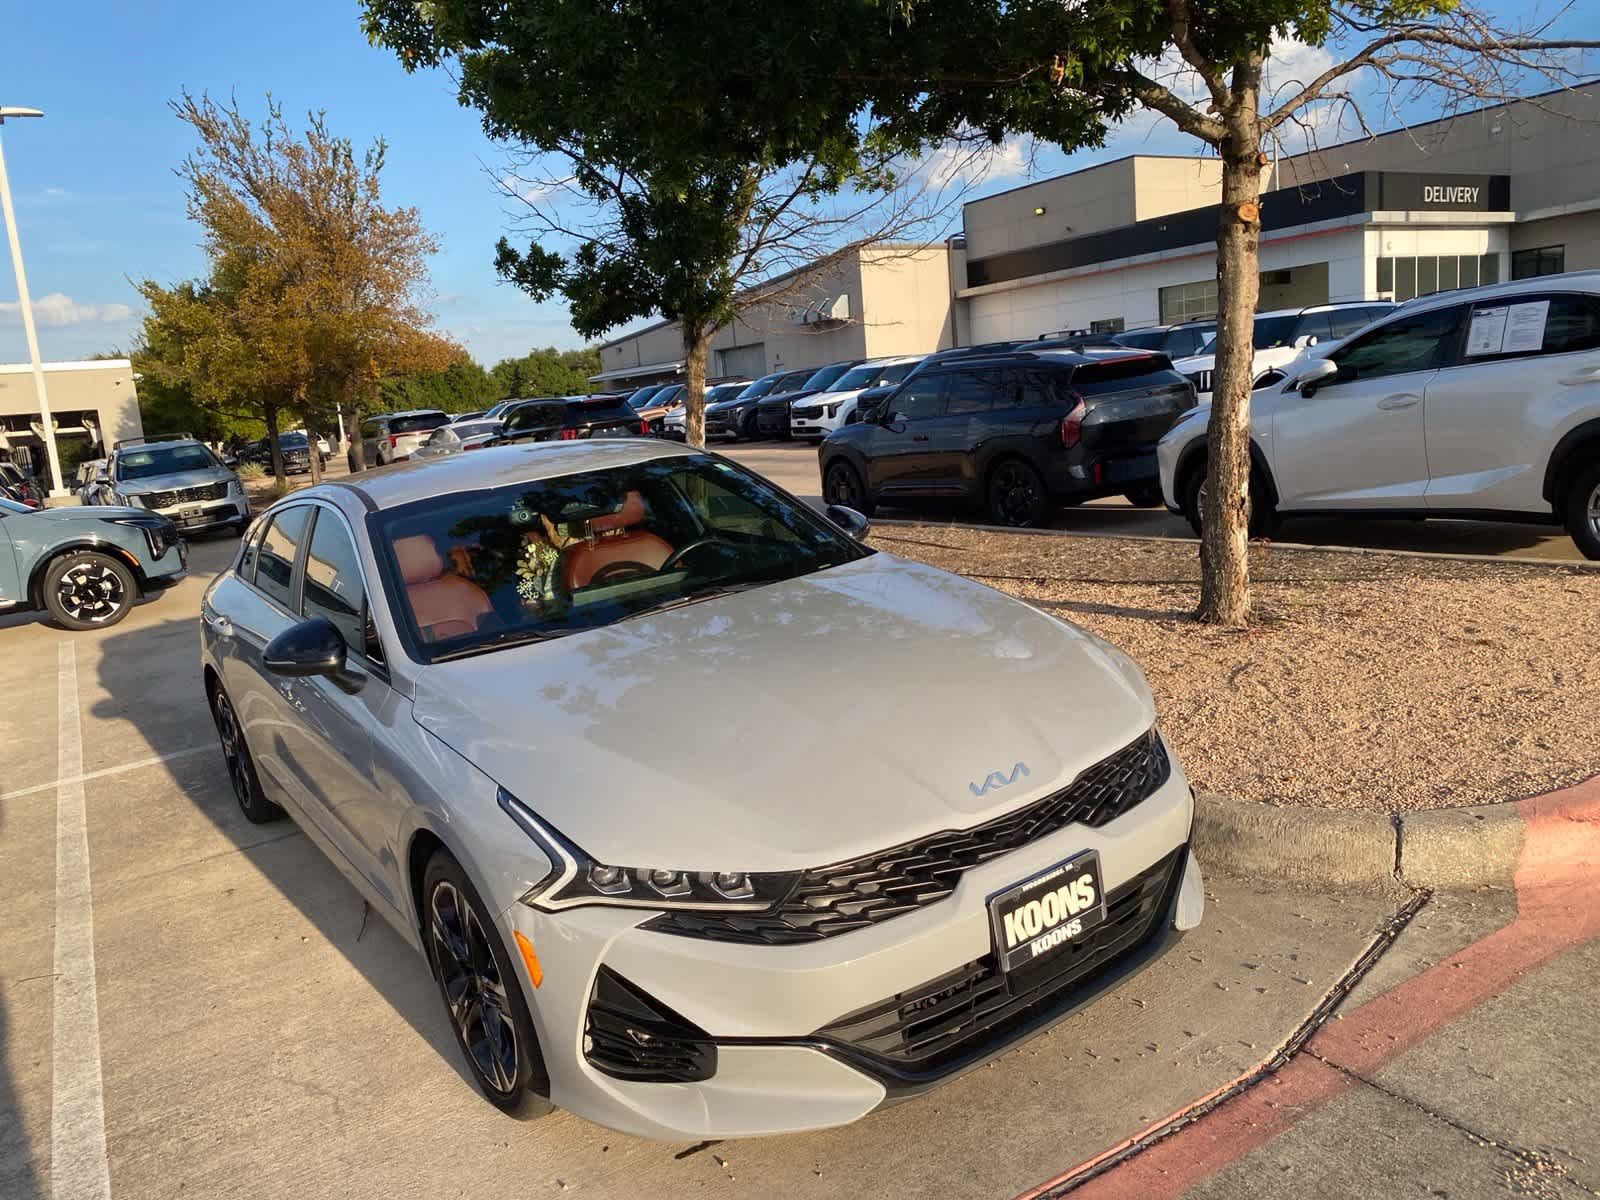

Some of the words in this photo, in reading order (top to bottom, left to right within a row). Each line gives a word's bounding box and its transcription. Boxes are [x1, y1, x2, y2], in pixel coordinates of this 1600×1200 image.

[1424, 186, 1479, 203] DELIVERY
[1003, 873, 1096, 948] KOONS
[1030, 919, 1083, 958] KOONS
